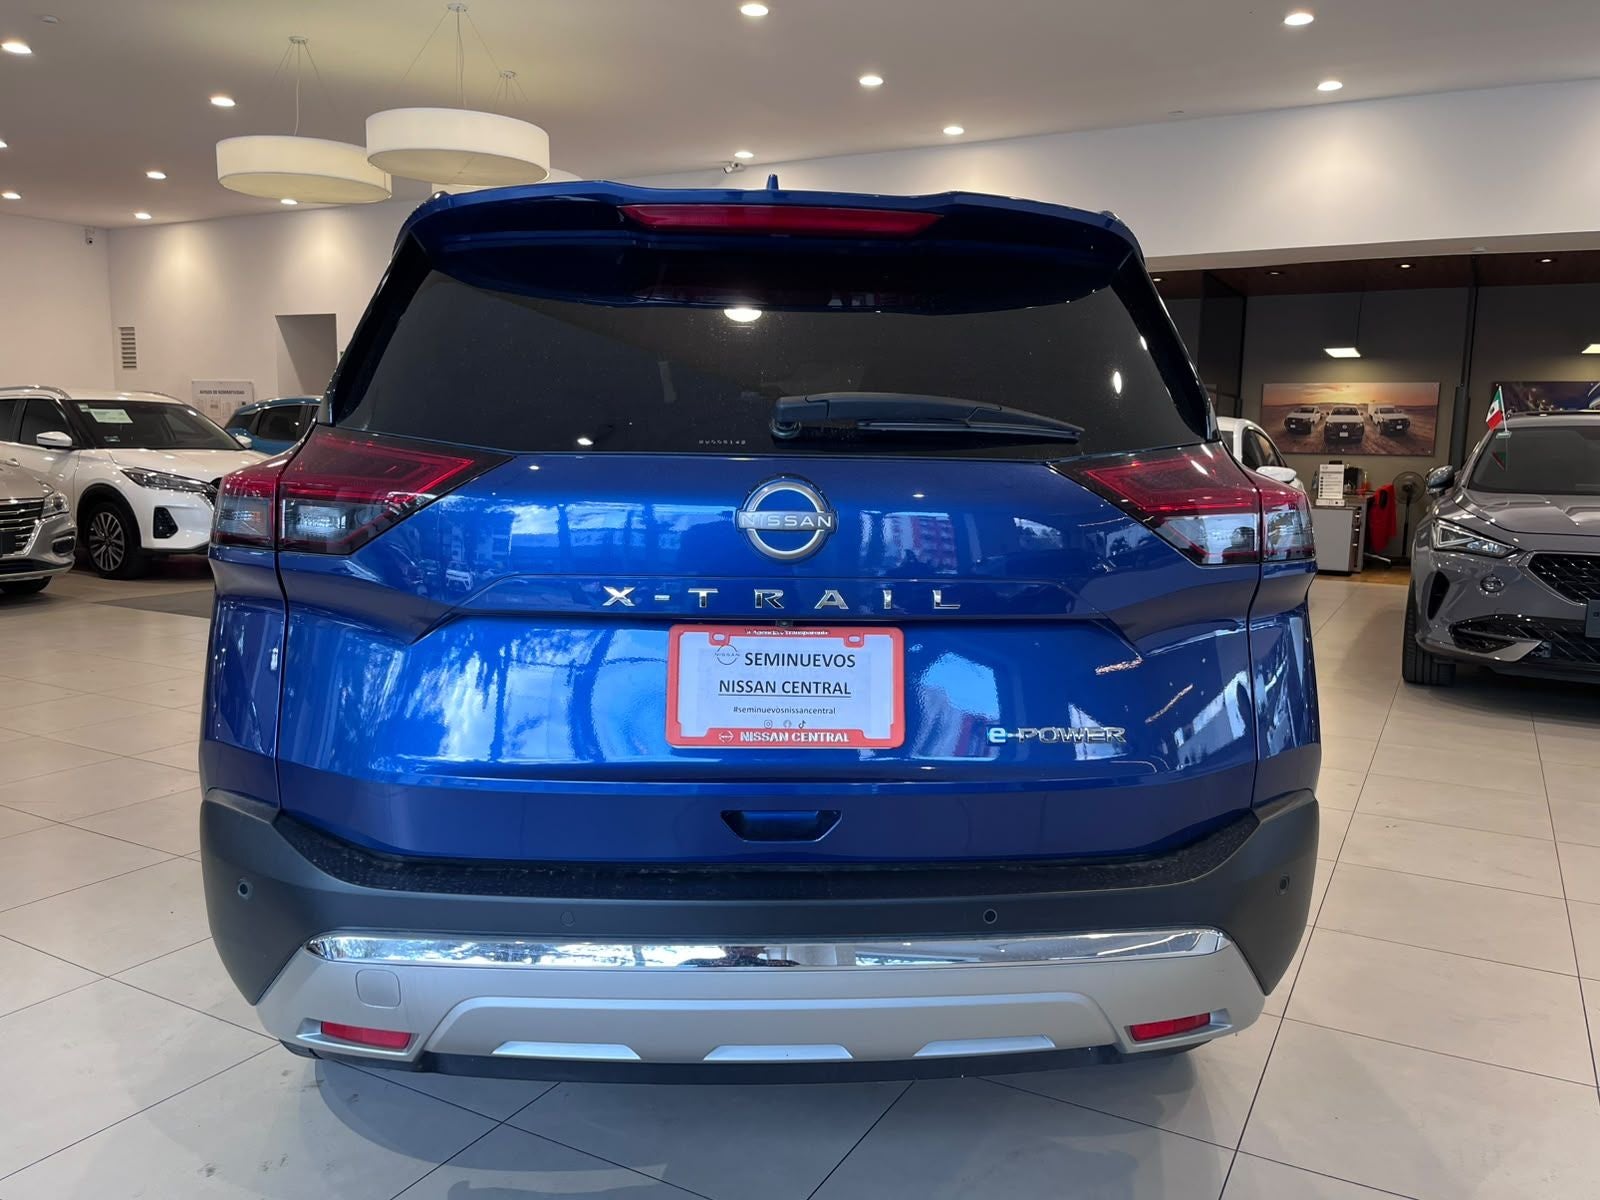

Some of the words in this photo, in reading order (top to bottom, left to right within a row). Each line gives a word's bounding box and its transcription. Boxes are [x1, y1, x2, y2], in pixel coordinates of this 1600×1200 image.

[741, 515, 832, 527] NISSAN
[602, 586, 961, 609] X-TRAIL
[744, 652, 856, 668] SEMINUEVOS
[719, 680, 777, 694] NISSAN
[781, 681, 851, 695] CENTRAL
[733, 706, 836, 715] #seminuevosnissancentral
[740, 731, 789, 742] NISSAN
[791, 733, 850, 743] CENTRAL
[988, 727, 1126, 743] e-POWER
